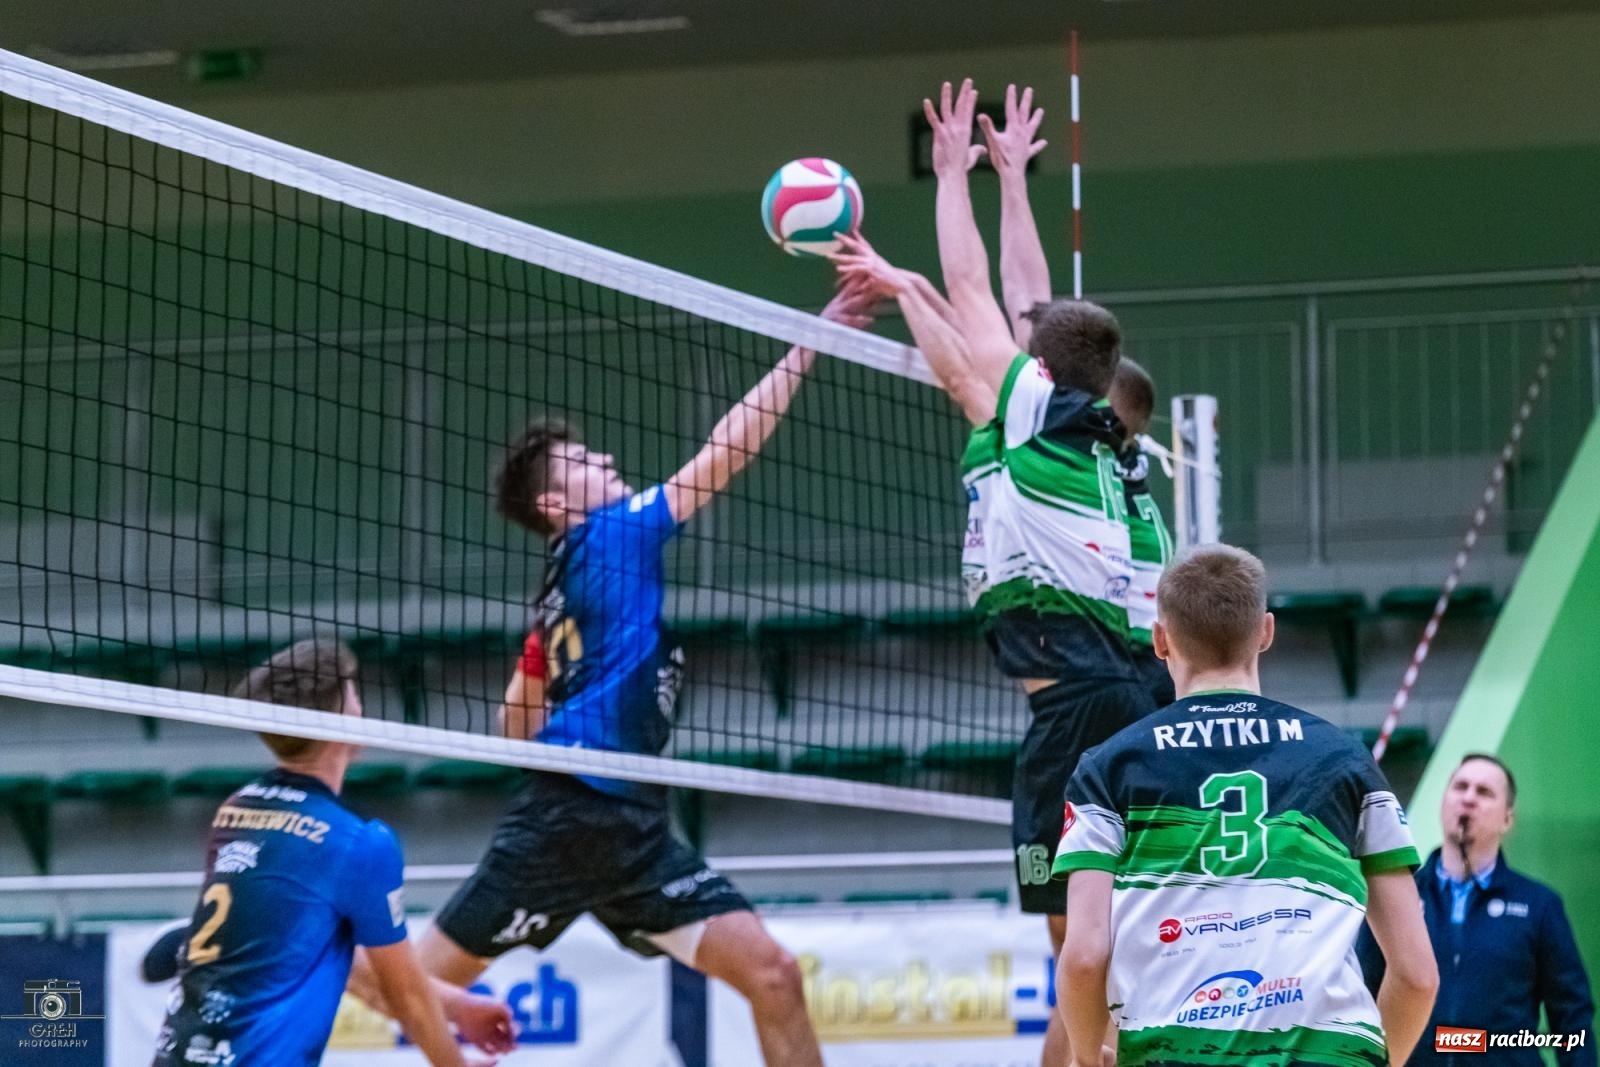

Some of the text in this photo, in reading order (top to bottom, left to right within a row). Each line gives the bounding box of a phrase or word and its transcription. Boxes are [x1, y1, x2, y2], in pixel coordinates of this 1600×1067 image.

[1188, 702, 1258, 712] #TeamKSR
[1153, 718, 1304, 750] RZYTKI M
[1200, 770, 1268, 878] 3
[1017, 844, 1050, 886] 16
[188, 883, 232, 965] 2
[1184, 912, 1233, 923] RADIO
[1185, 909, 1312, 936] VANESSA
[1256, 977, 1302, 994] MULTI
[1177, 989, 1304, 1023] UBEZPIECZENIA
